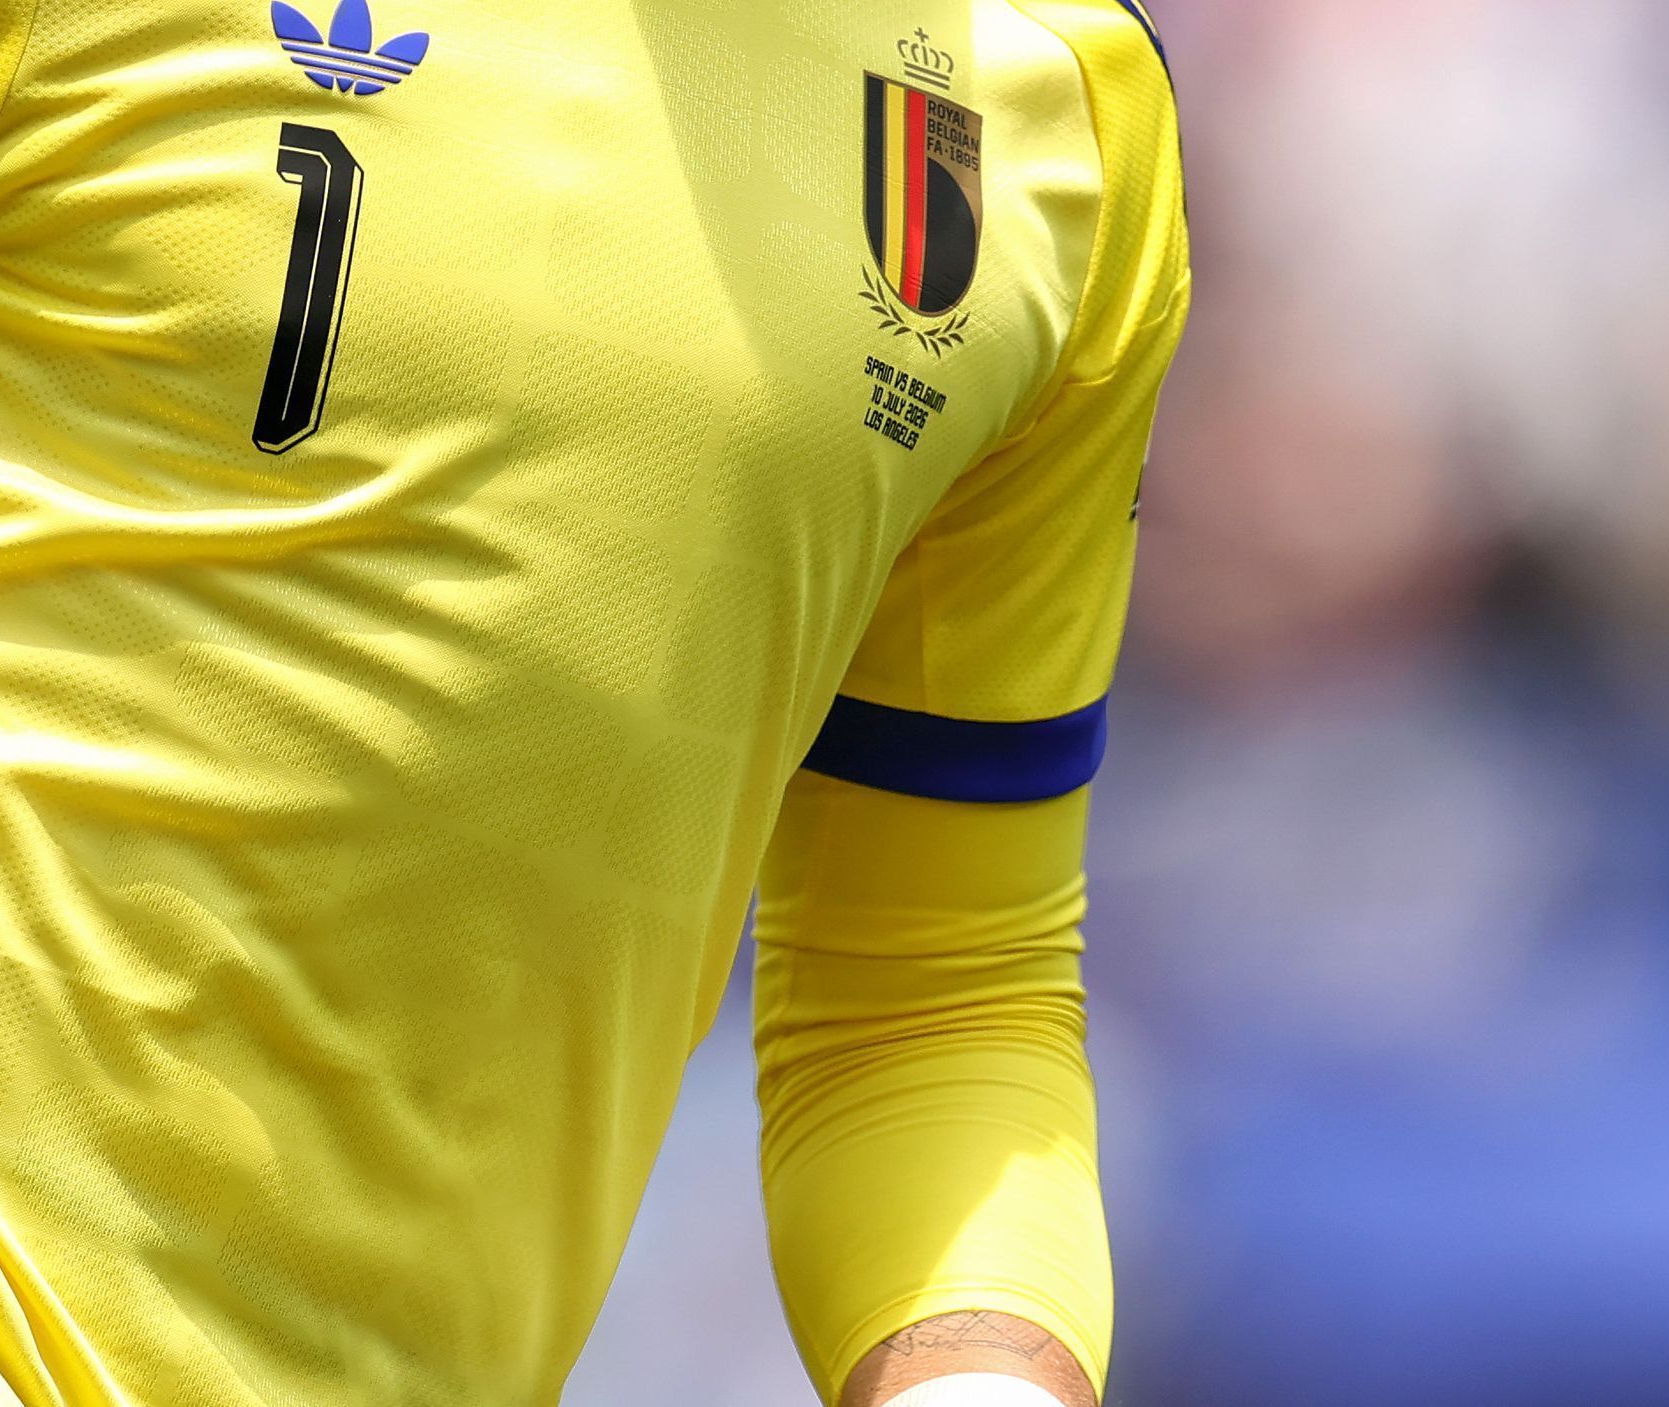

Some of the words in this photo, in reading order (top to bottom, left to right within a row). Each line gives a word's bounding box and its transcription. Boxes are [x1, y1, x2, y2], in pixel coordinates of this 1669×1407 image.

[927, 118, 979, 154] BELGIAN
[928, 100, 967, 129] ROYAL
[252, 122, 364, 455] 1
[871, 384, 883, 405] 10
[883, 391, 907, 416] JULY
[904, 403, 929, 429] 2026
[894, 370, 909, 392] VS
[908, 378, 947, 414] BELGIUM
[864, 407, 884, 431] LOS
[881, 417, 920, 450] ANGELES
